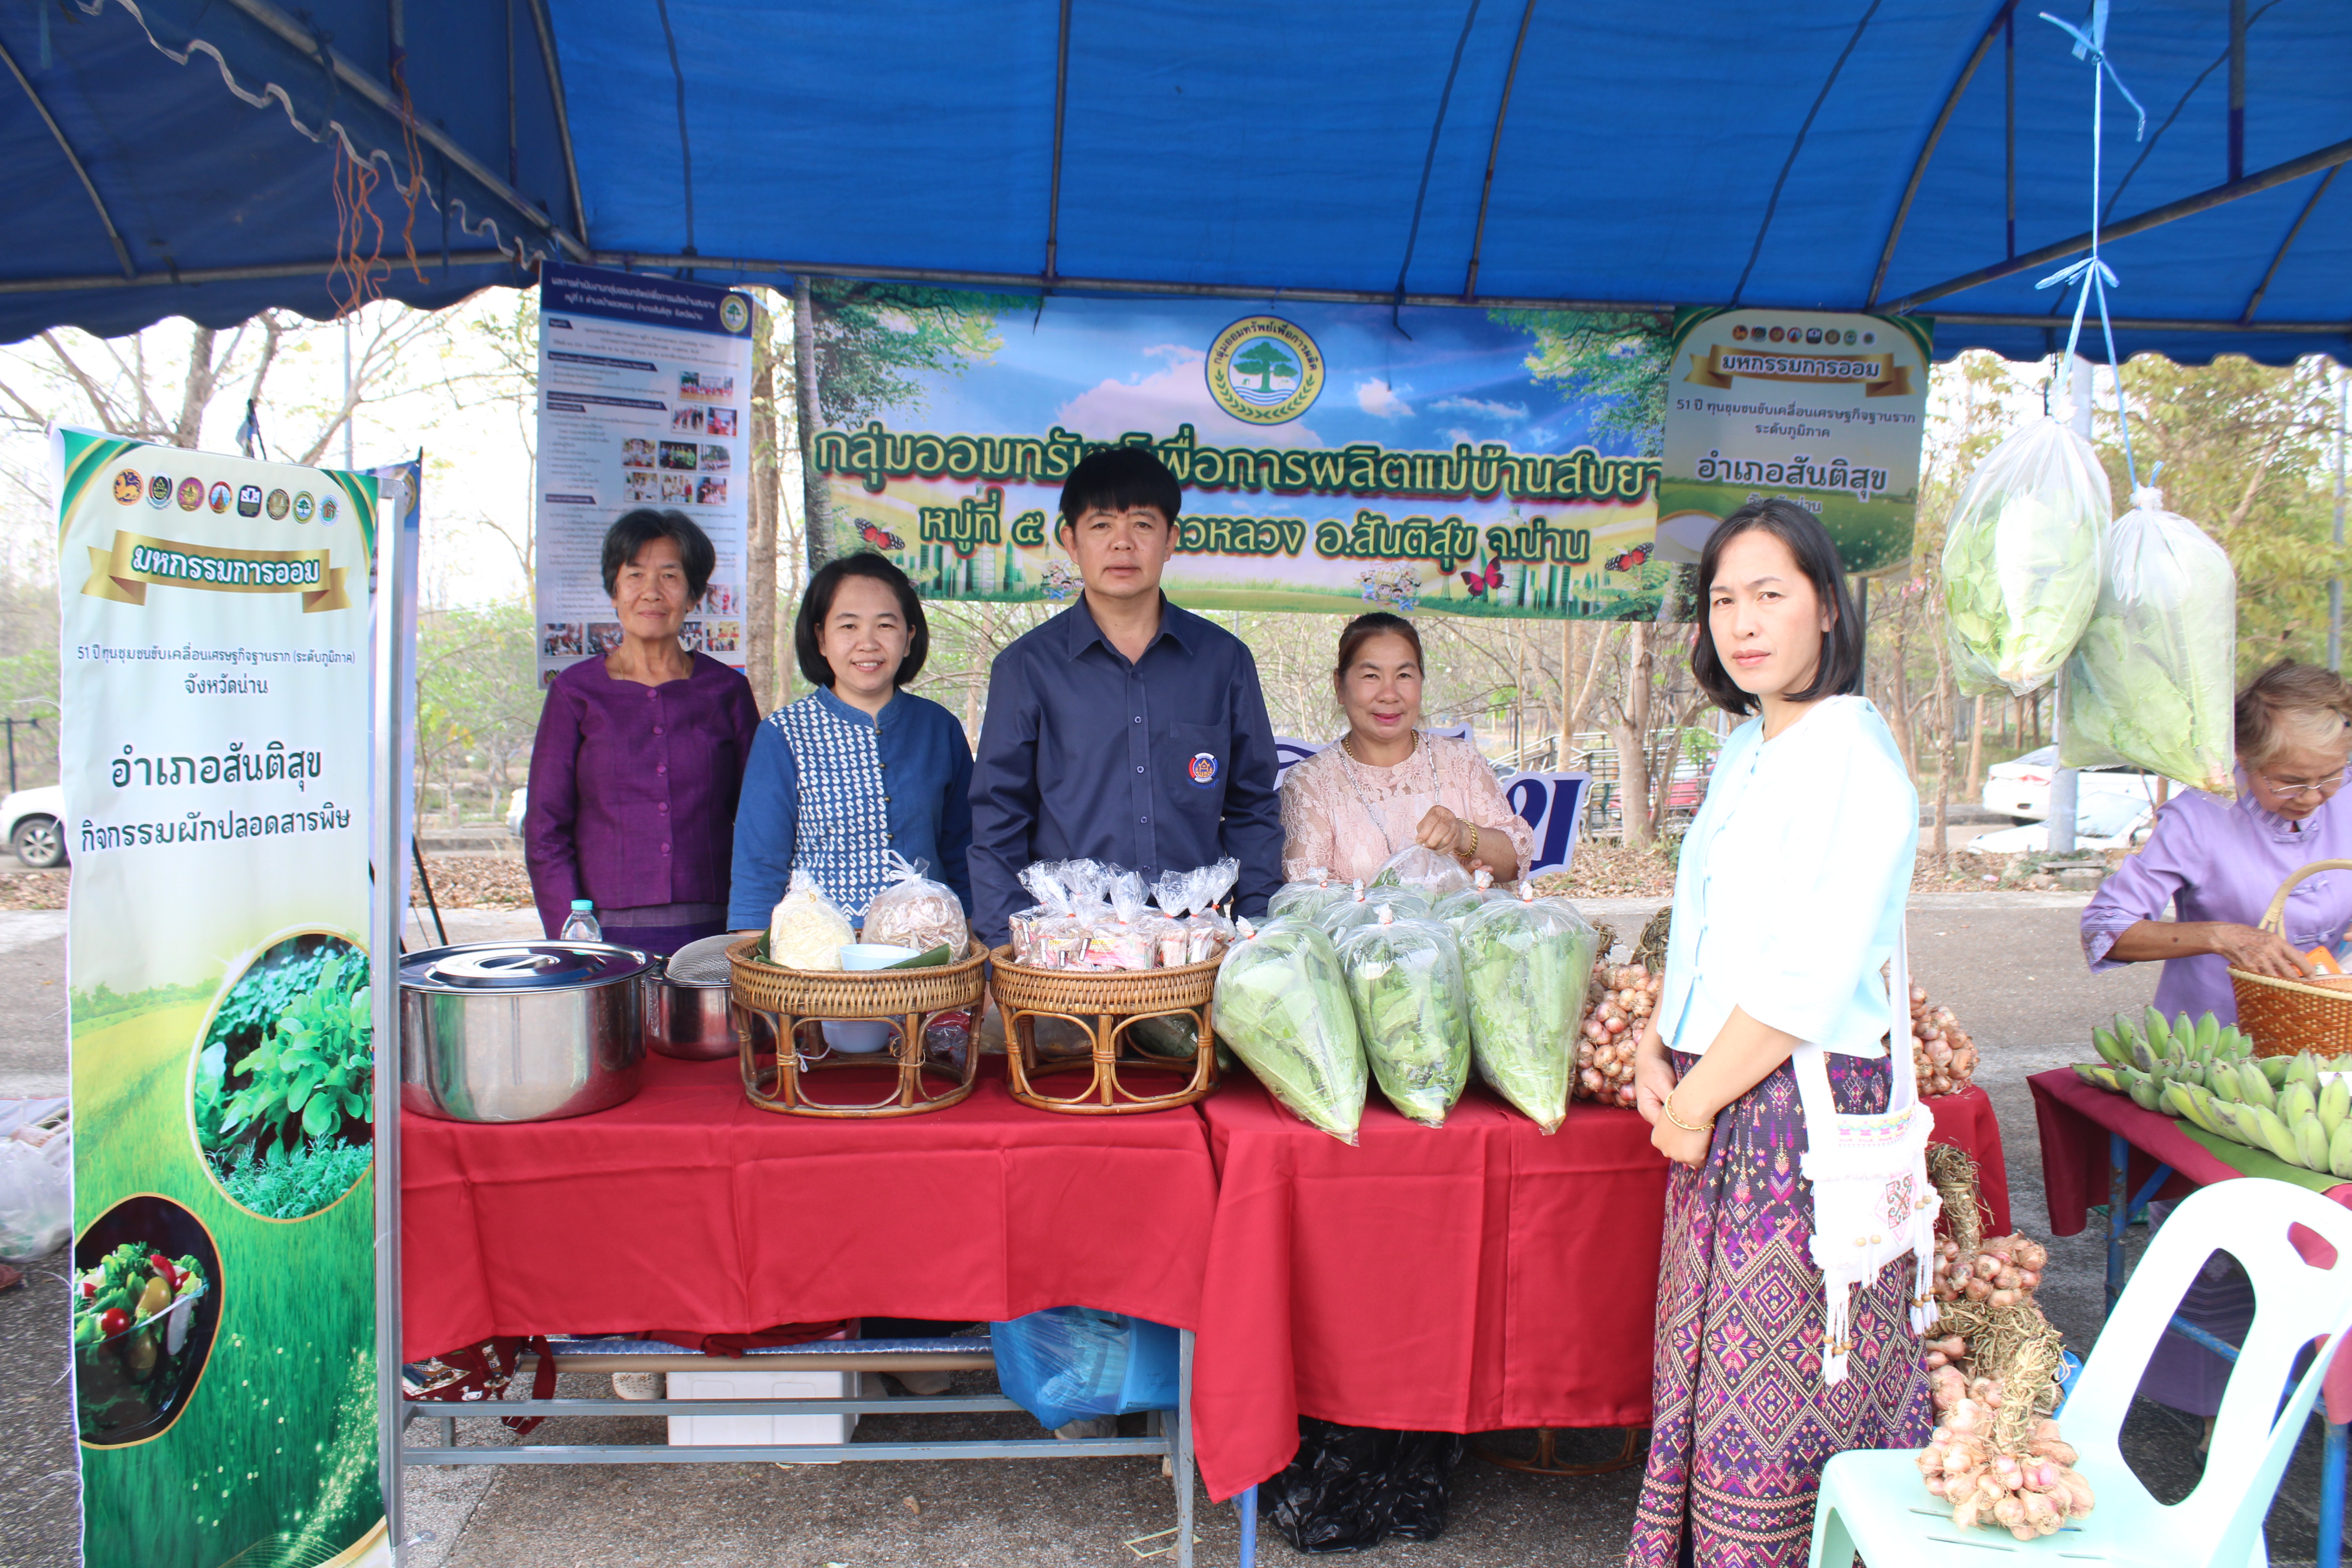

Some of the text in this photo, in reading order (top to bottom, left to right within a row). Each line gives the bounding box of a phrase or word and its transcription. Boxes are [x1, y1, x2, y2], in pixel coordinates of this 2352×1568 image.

[1722, 355, 1880, 378] มหกรรมการออม
[1676, 398, 1916, 425] 51 ปี ทุนชุมชนขับเคลื่อนเศรษฐกิจฐานราก
[1755, 423, 1831, 439] ระดับภูมิภาค
[1698, 450, 1887, 499] อำเภอสันติสุข
[922, 489, 999, 551] หมู่ที่
[1013, 510, 1044, 544] ๕
[1319, 512, 1475, 571] อ.สันติสุข
[1488, 520, 1588, 560] จ.น่าน
[132, 544, 321, 585] มหกรรมการออม
[77, 642, 355, 667] 51 ปี ทุนชุมชนขับเคลื่อนเศรษฐกิจฐานราก (ระดับภูมิภาค)
[184, 672, 269, 694] จังหวัดน่าน
[111, 741, 322, 792] อำเภอสันติสุข
[81, 802, 351, 852] กิจกรรมผักปลอดสารพิษ
